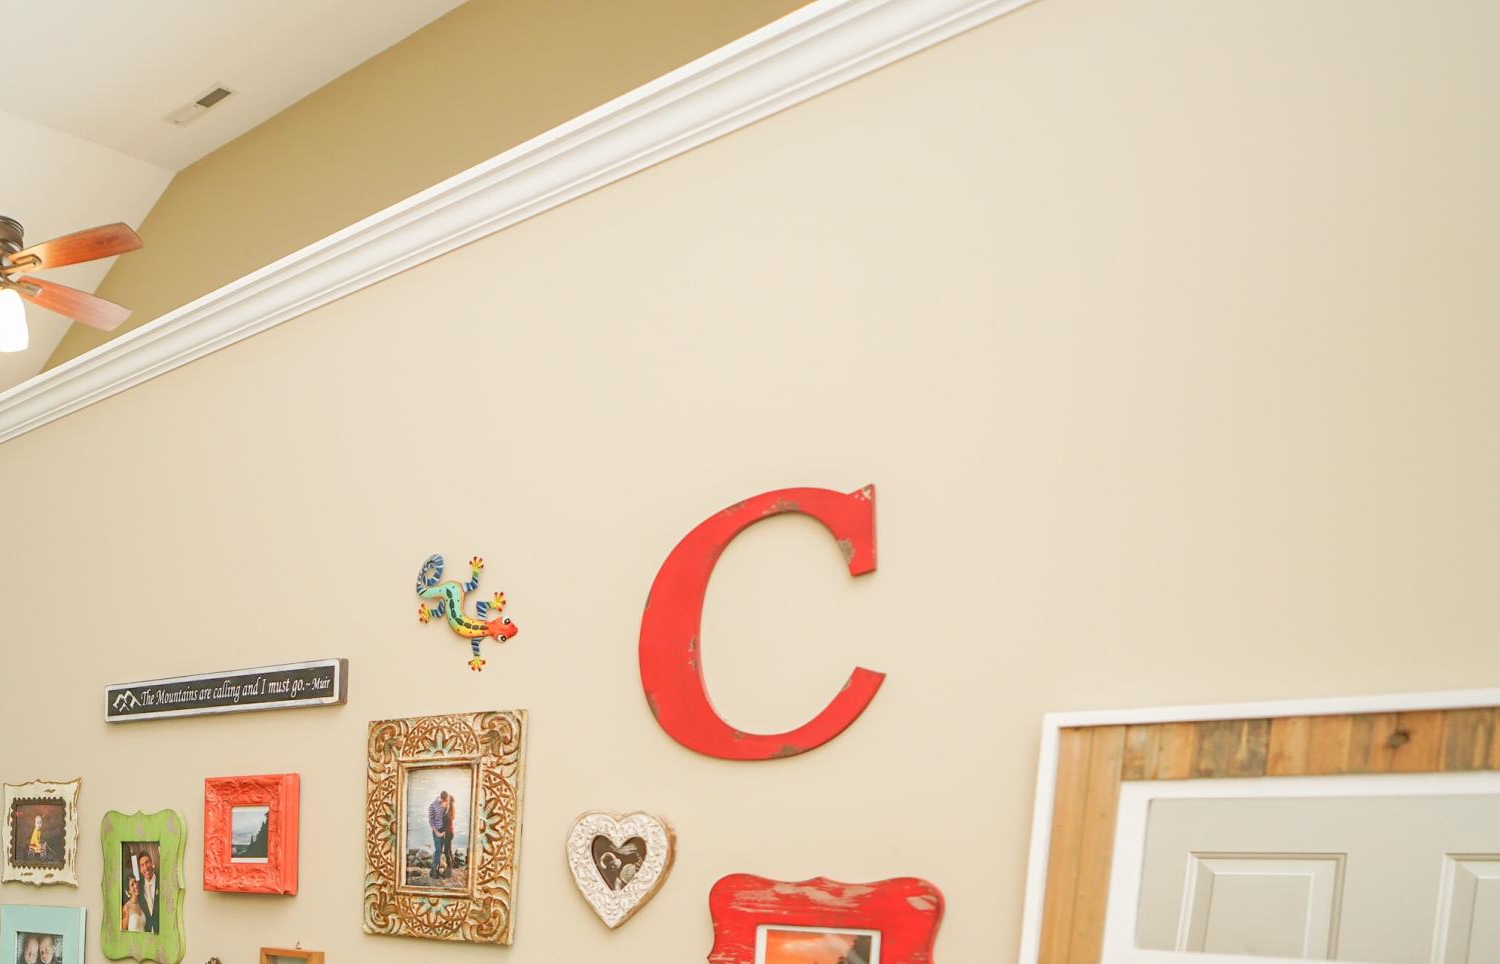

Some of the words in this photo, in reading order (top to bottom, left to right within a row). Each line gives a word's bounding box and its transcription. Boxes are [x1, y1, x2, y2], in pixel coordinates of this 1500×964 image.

[141, 688, 154, 706] The
[155, 686, 197, 705] Mountains
[199, 688, 211, 700] are
[213, 680, 240, 703] calling
[242, 677, 261, 696] and
[261, 679, 267, 695] I
[268, 678, 290, 694] must
[638, 483, 886, 762] C
